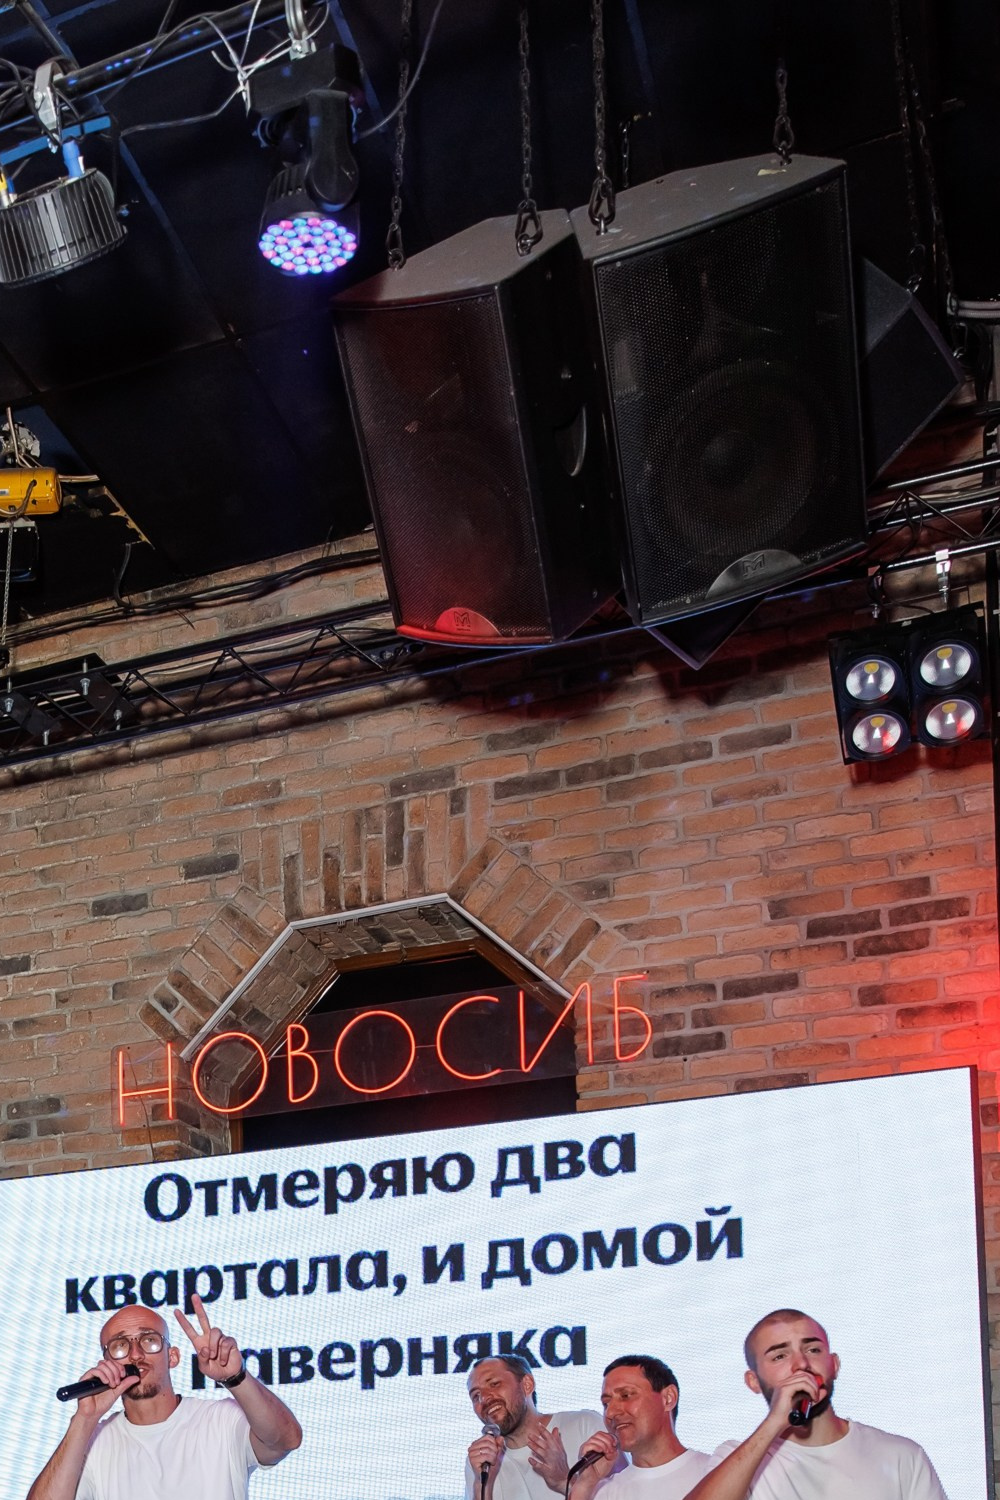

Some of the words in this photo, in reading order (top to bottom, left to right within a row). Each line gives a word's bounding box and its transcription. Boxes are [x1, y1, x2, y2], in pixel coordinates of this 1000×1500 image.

[118, 974, 653, 1127] НОВОСИБ
[144, 1151, 475, 1223] Отмеряю
[491, 1132, 636, 1198] два
[65, 1250, 407, 1315] квартала,
[422, 1243, 465, 1284] и
[481, 1205, 743, 1290] домой
